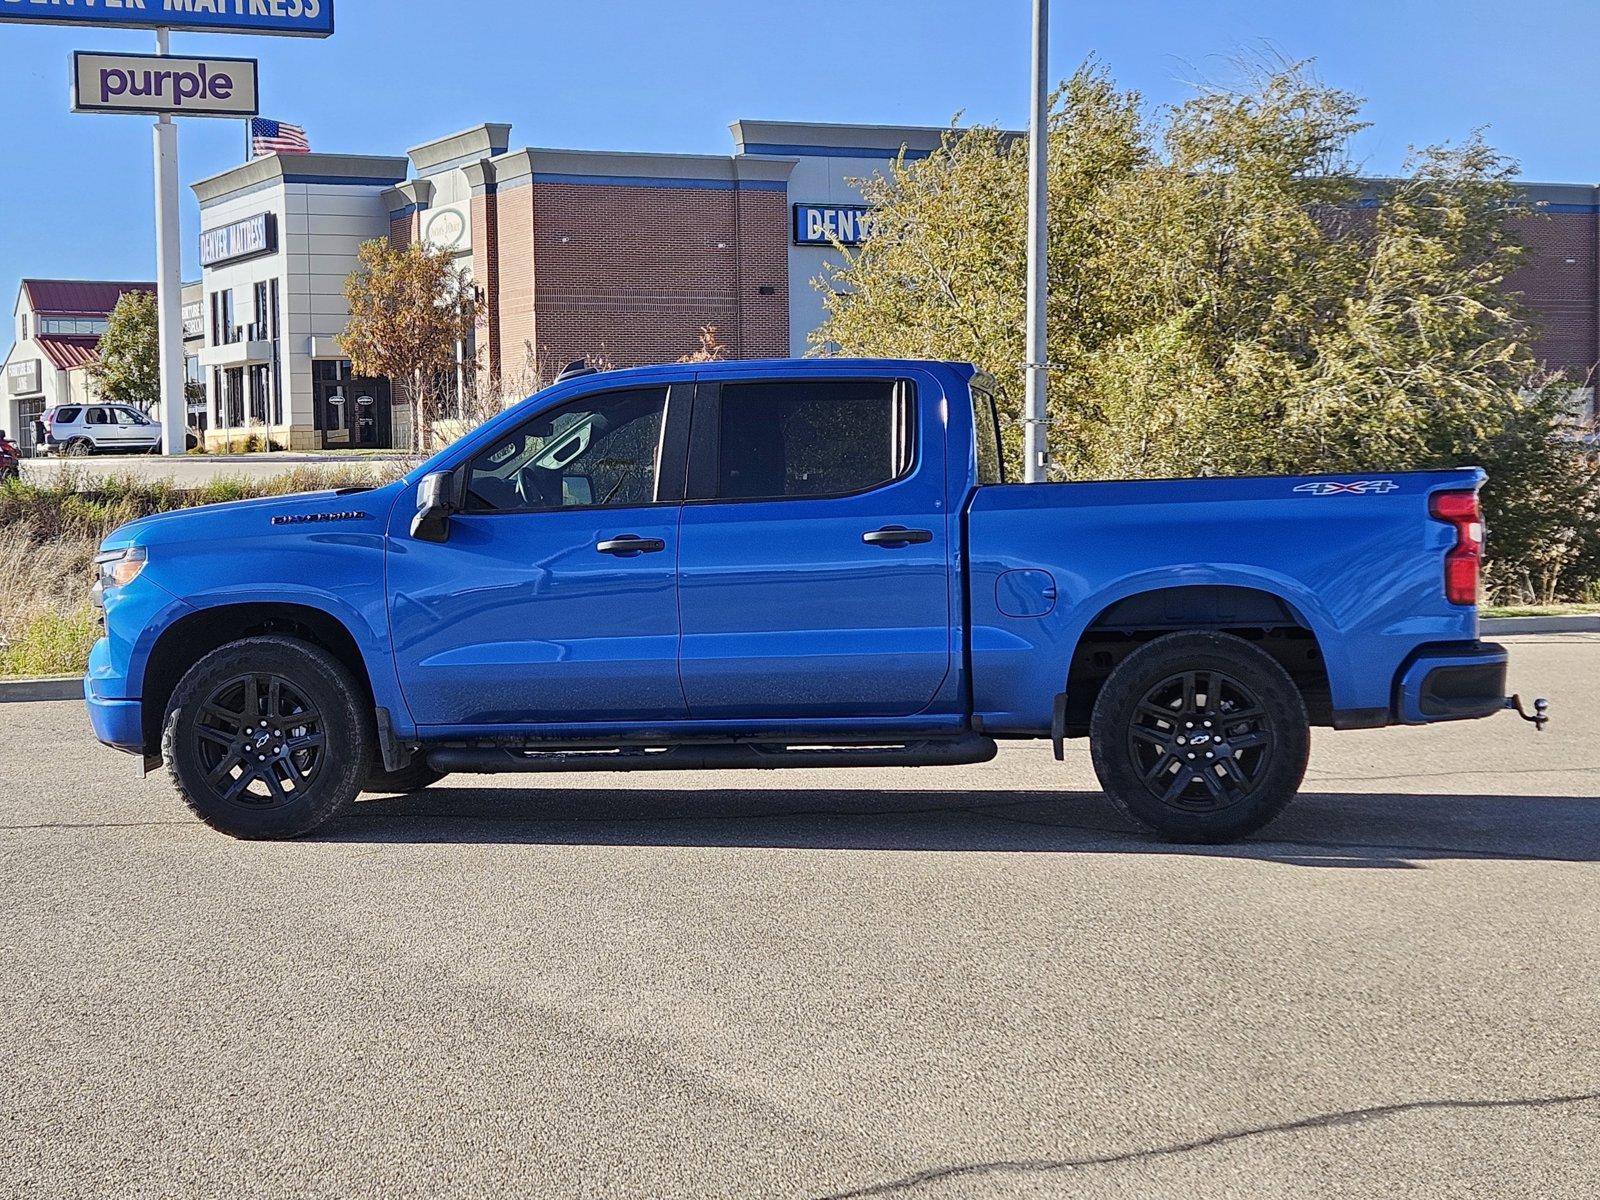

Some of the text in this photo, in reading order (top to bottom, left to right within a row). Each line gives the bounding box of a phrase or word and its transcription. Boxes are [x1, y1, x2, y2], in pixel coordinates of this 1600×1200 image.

[100, 63, 233, 105] purple
[201, 217, 264, 262] DENVER MATTRESS
